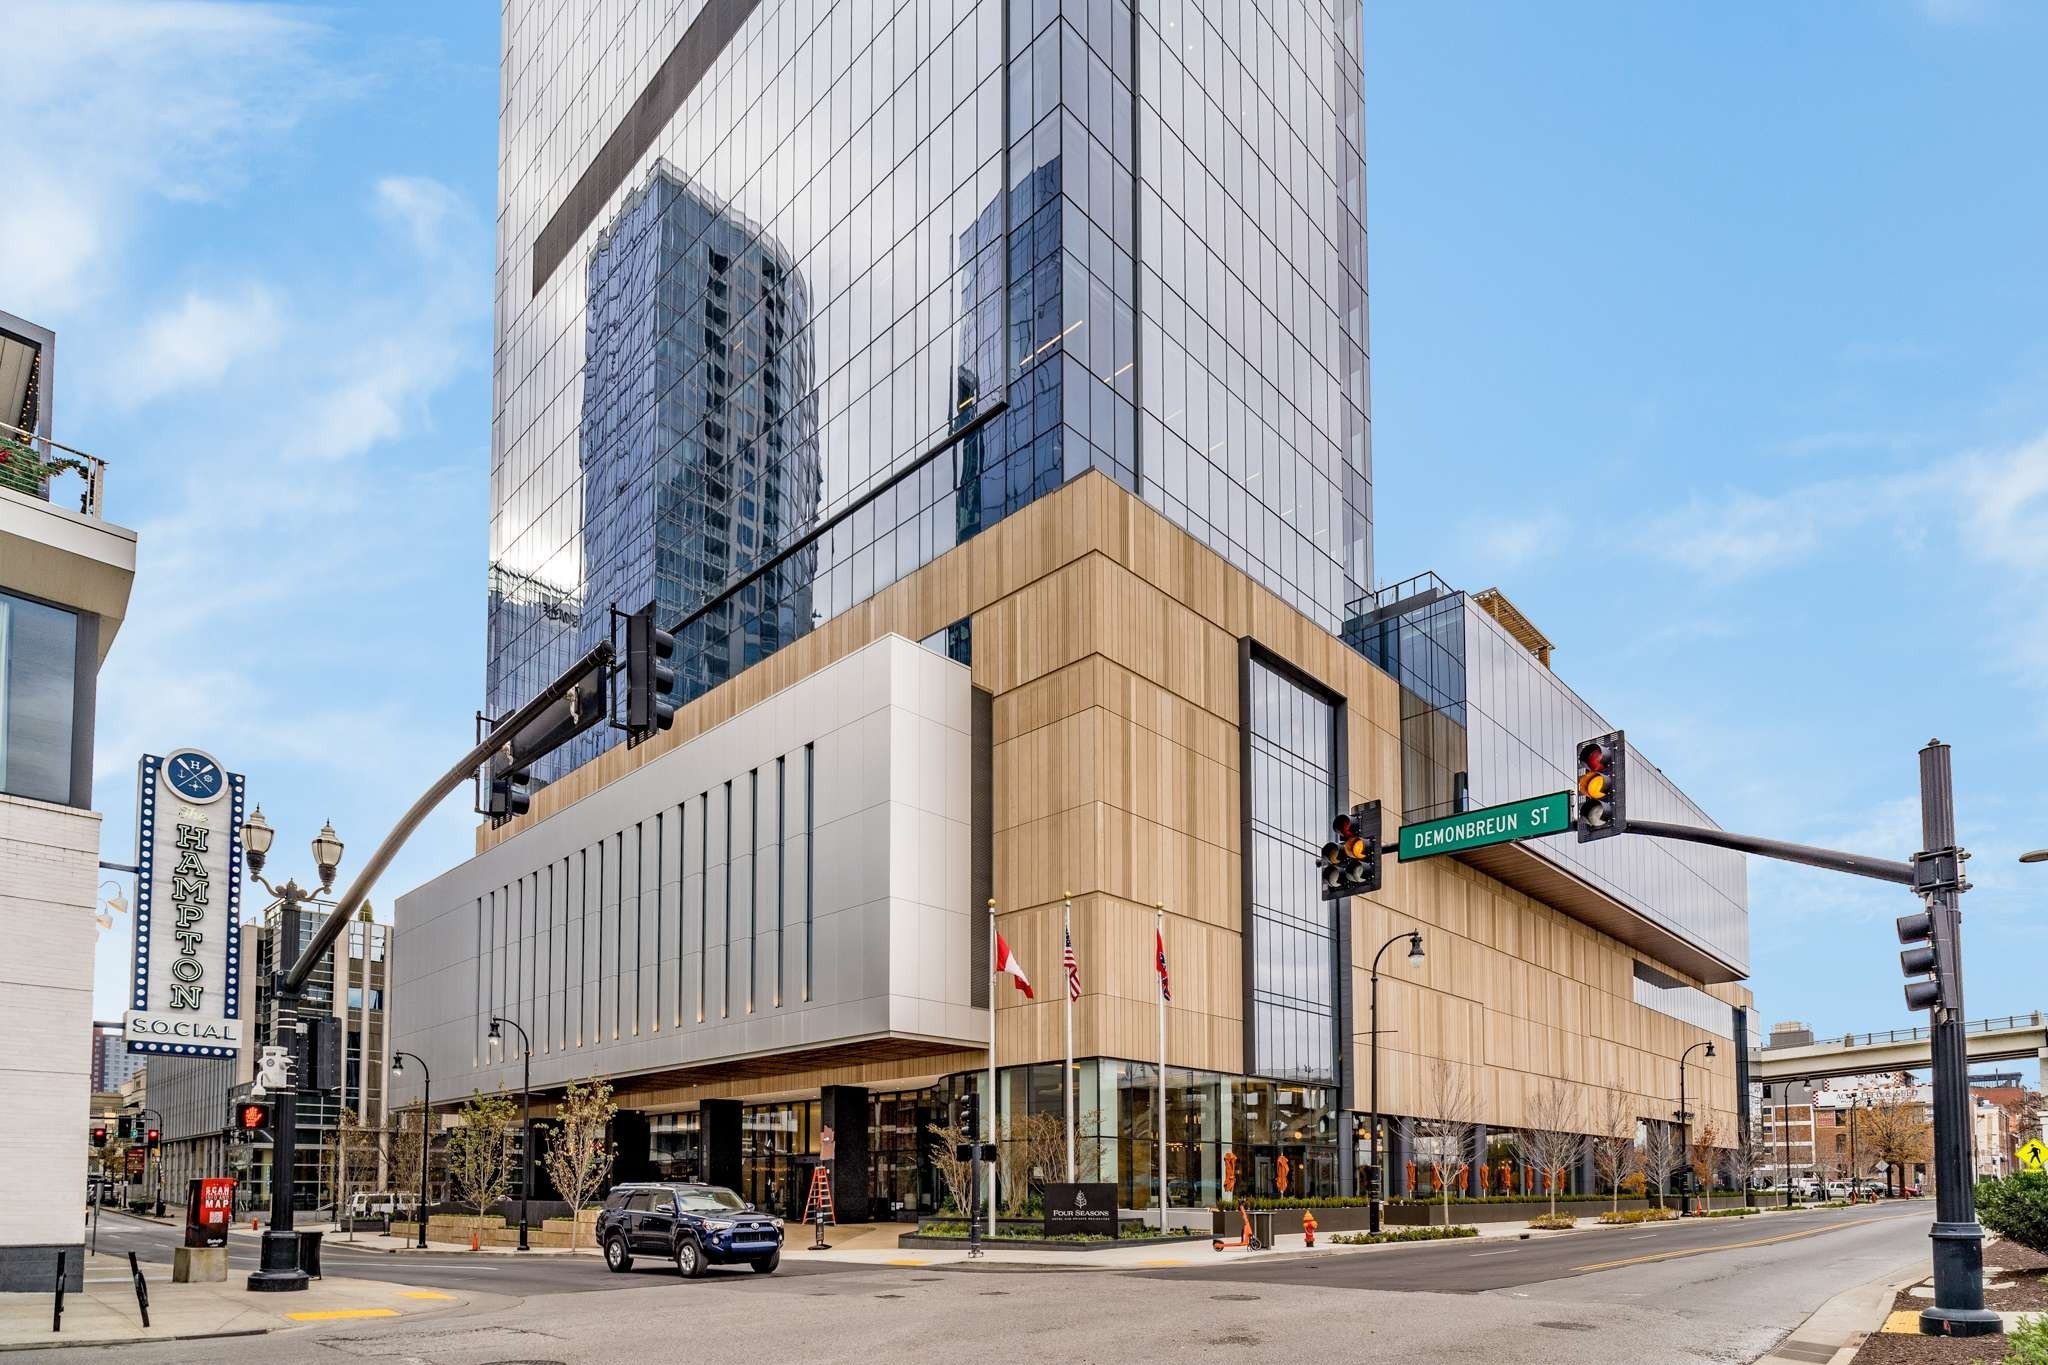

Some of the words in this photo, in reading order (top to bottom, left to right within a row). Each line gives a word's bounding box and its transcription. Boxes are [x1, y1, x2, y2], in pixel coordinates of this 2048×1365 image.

[190, 760, 201, 770] H
[1414, 813, 1518, 849] DEMONBREUN
[1530, 806, 1550, 826] ST
[170, 823, 210, 1010] HAMPTON
[132, 1018, 237, 1041] SOCIAL
[205, 1186, 230, 1195] SCAN
[205, 1199, 229, 1208] MAP
[1053, 1209, 1074, 1217] FOUR
[1075, 1209, 1109, 1217] SEASONS
